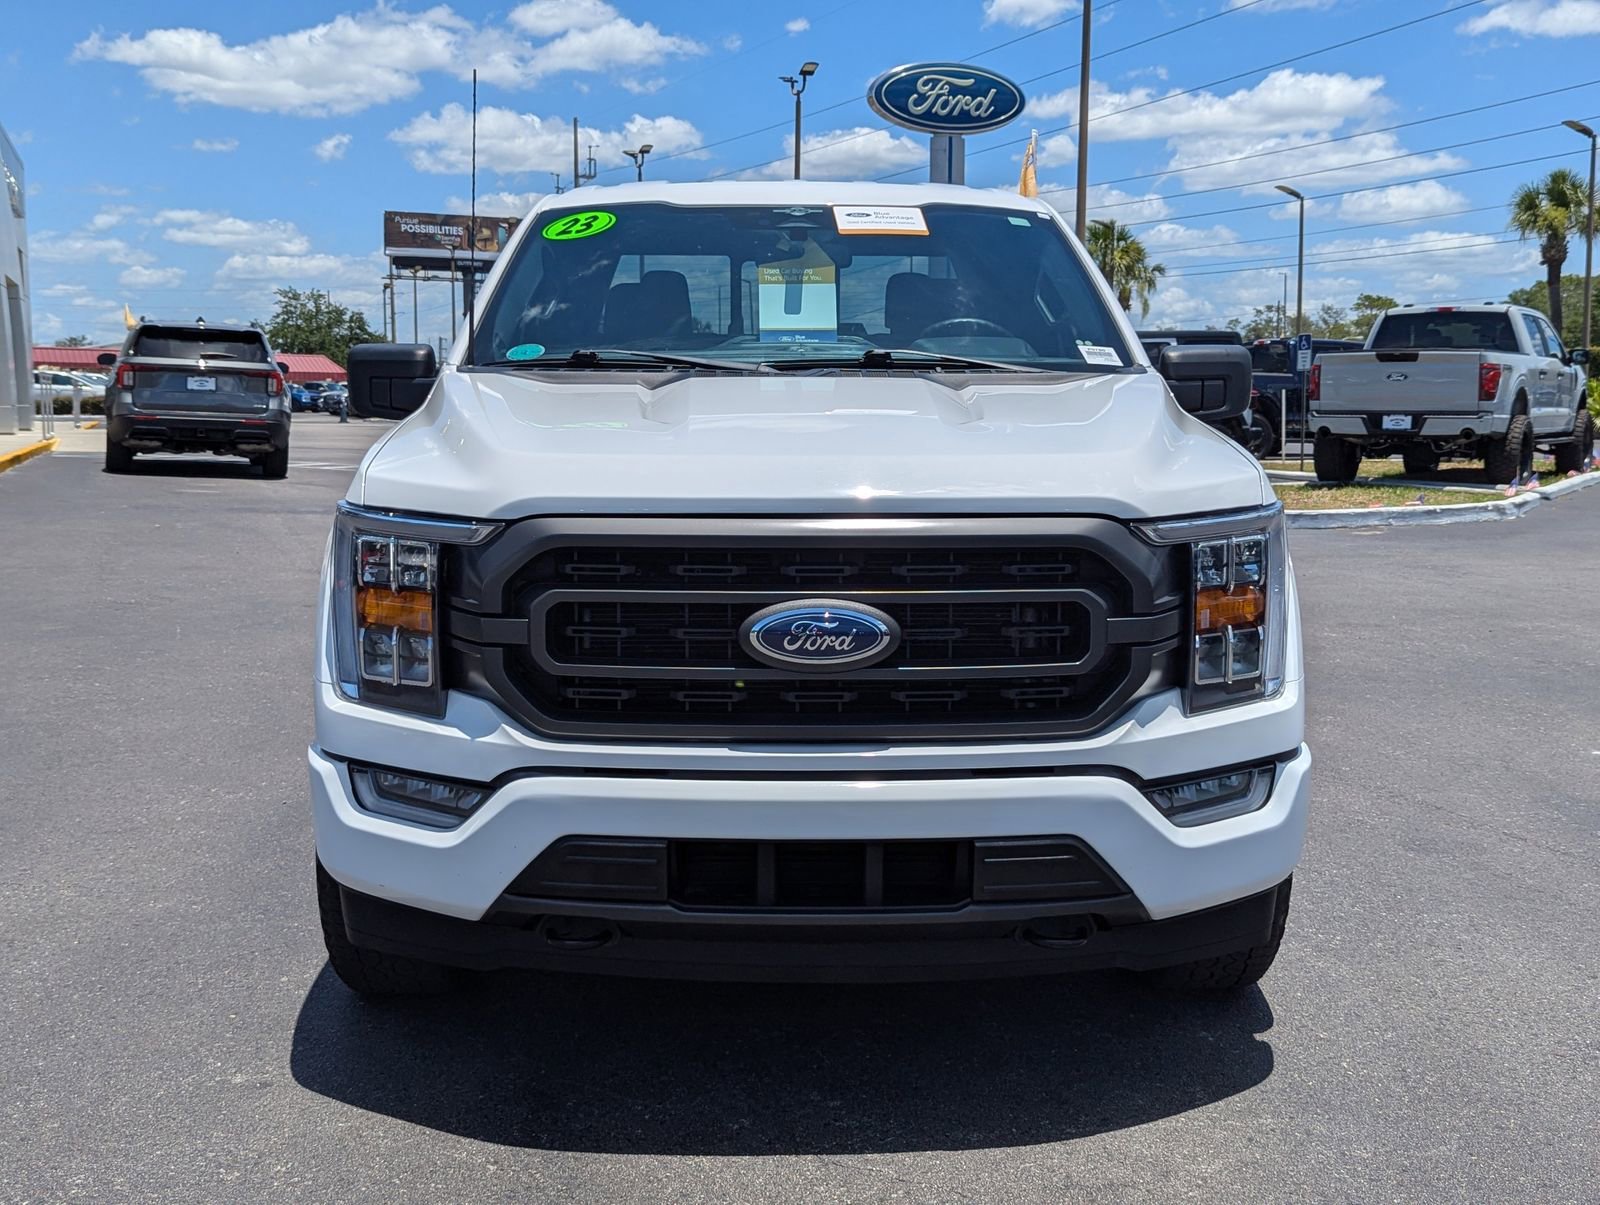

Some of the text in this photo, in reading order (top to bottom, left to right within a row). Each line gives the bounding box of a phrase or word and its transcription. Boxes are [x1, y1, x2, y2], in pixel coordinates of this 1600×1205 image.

[908, 74, 997, 118] Ford
[394, 215, 419, 224] Pursue
[401, 224, 464, 235] POSSIBILITIES
[555, 215, 599, 237] 23
[783, 620, 857, 651] Ford
